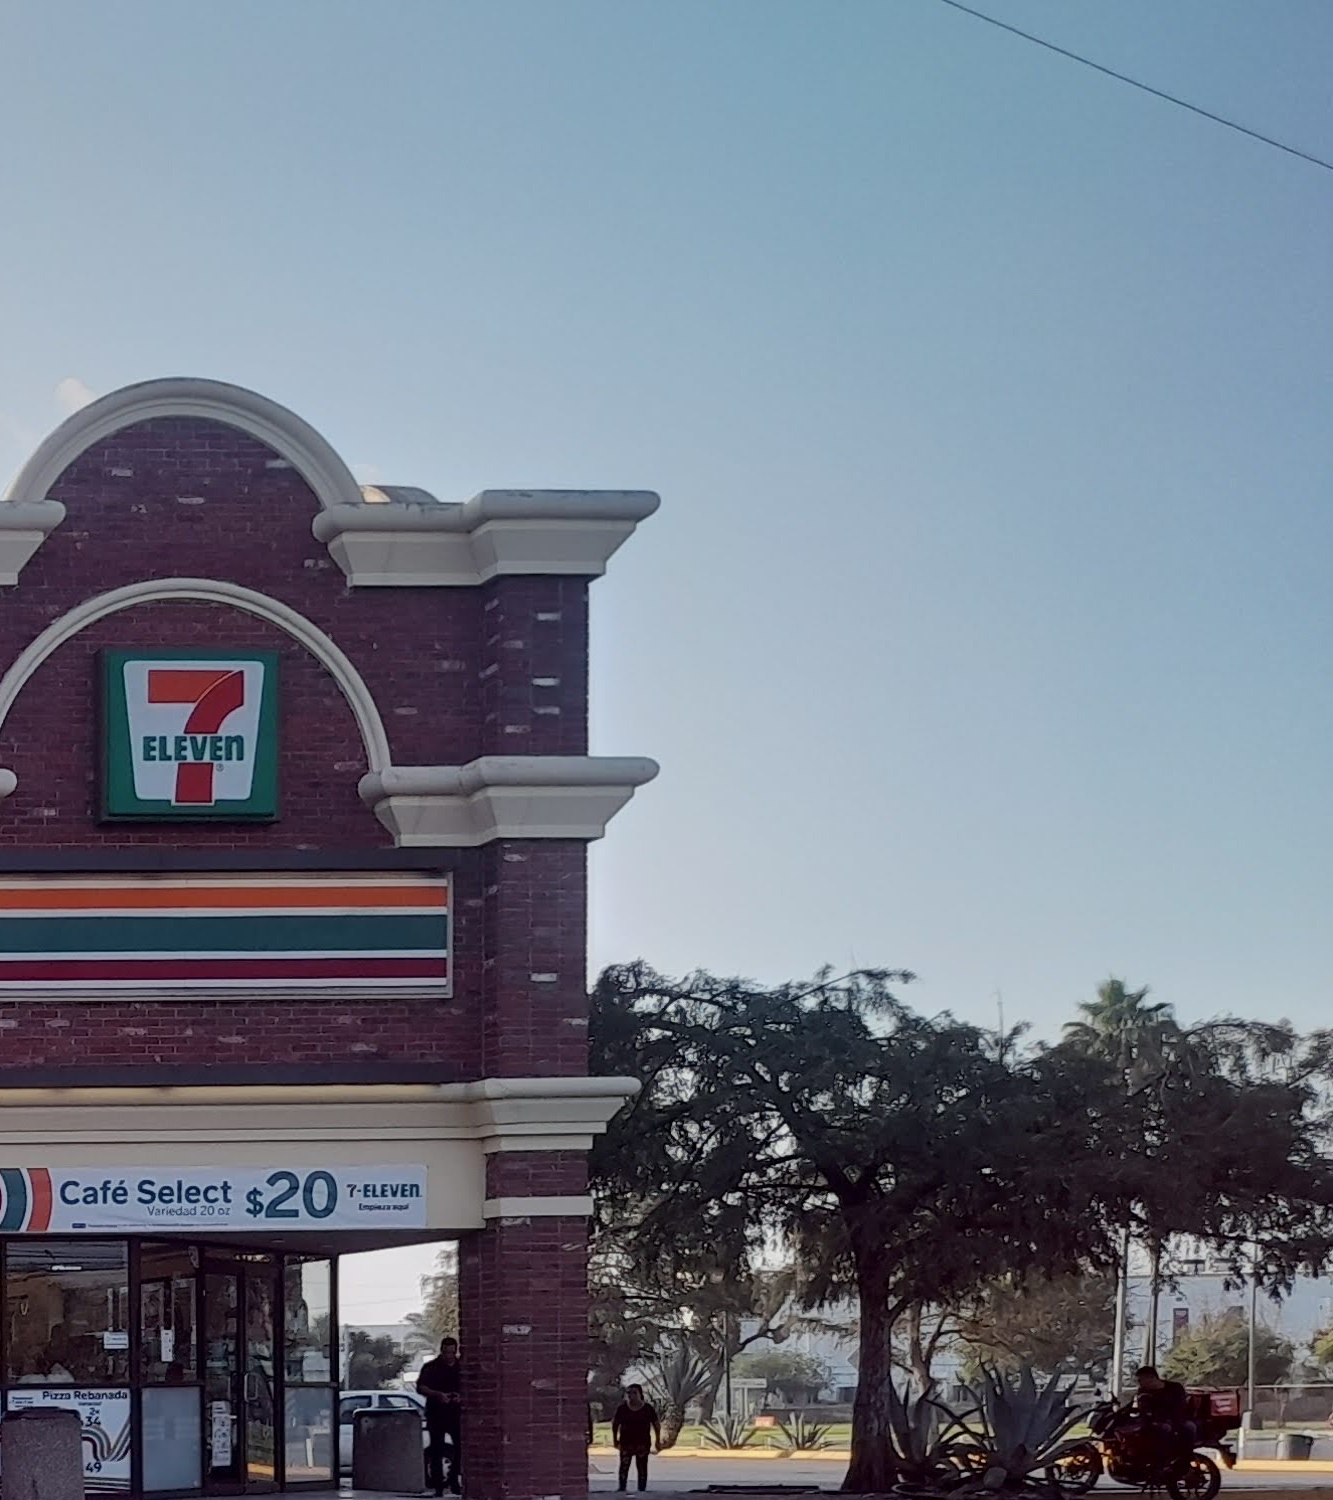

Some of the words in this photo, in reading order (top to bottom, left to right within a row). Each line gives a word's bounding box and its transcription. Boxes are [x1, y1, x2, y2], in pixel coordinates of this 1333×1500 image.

[148, 669, 245, 804] 7
[59, 1179, 129, 1205] Café
[136, 1179, 232, 1205] Select
[245, 1170, 338, 1218] $20
[147, 1205, 197, 1216] Variedad
[200, 1205, 215, 1216] 20
[217, 1206, 231, 1216] oz
[42, 1390, 71, 1400] Pizza
[73, 1390, 128, 1400] Rebanada
